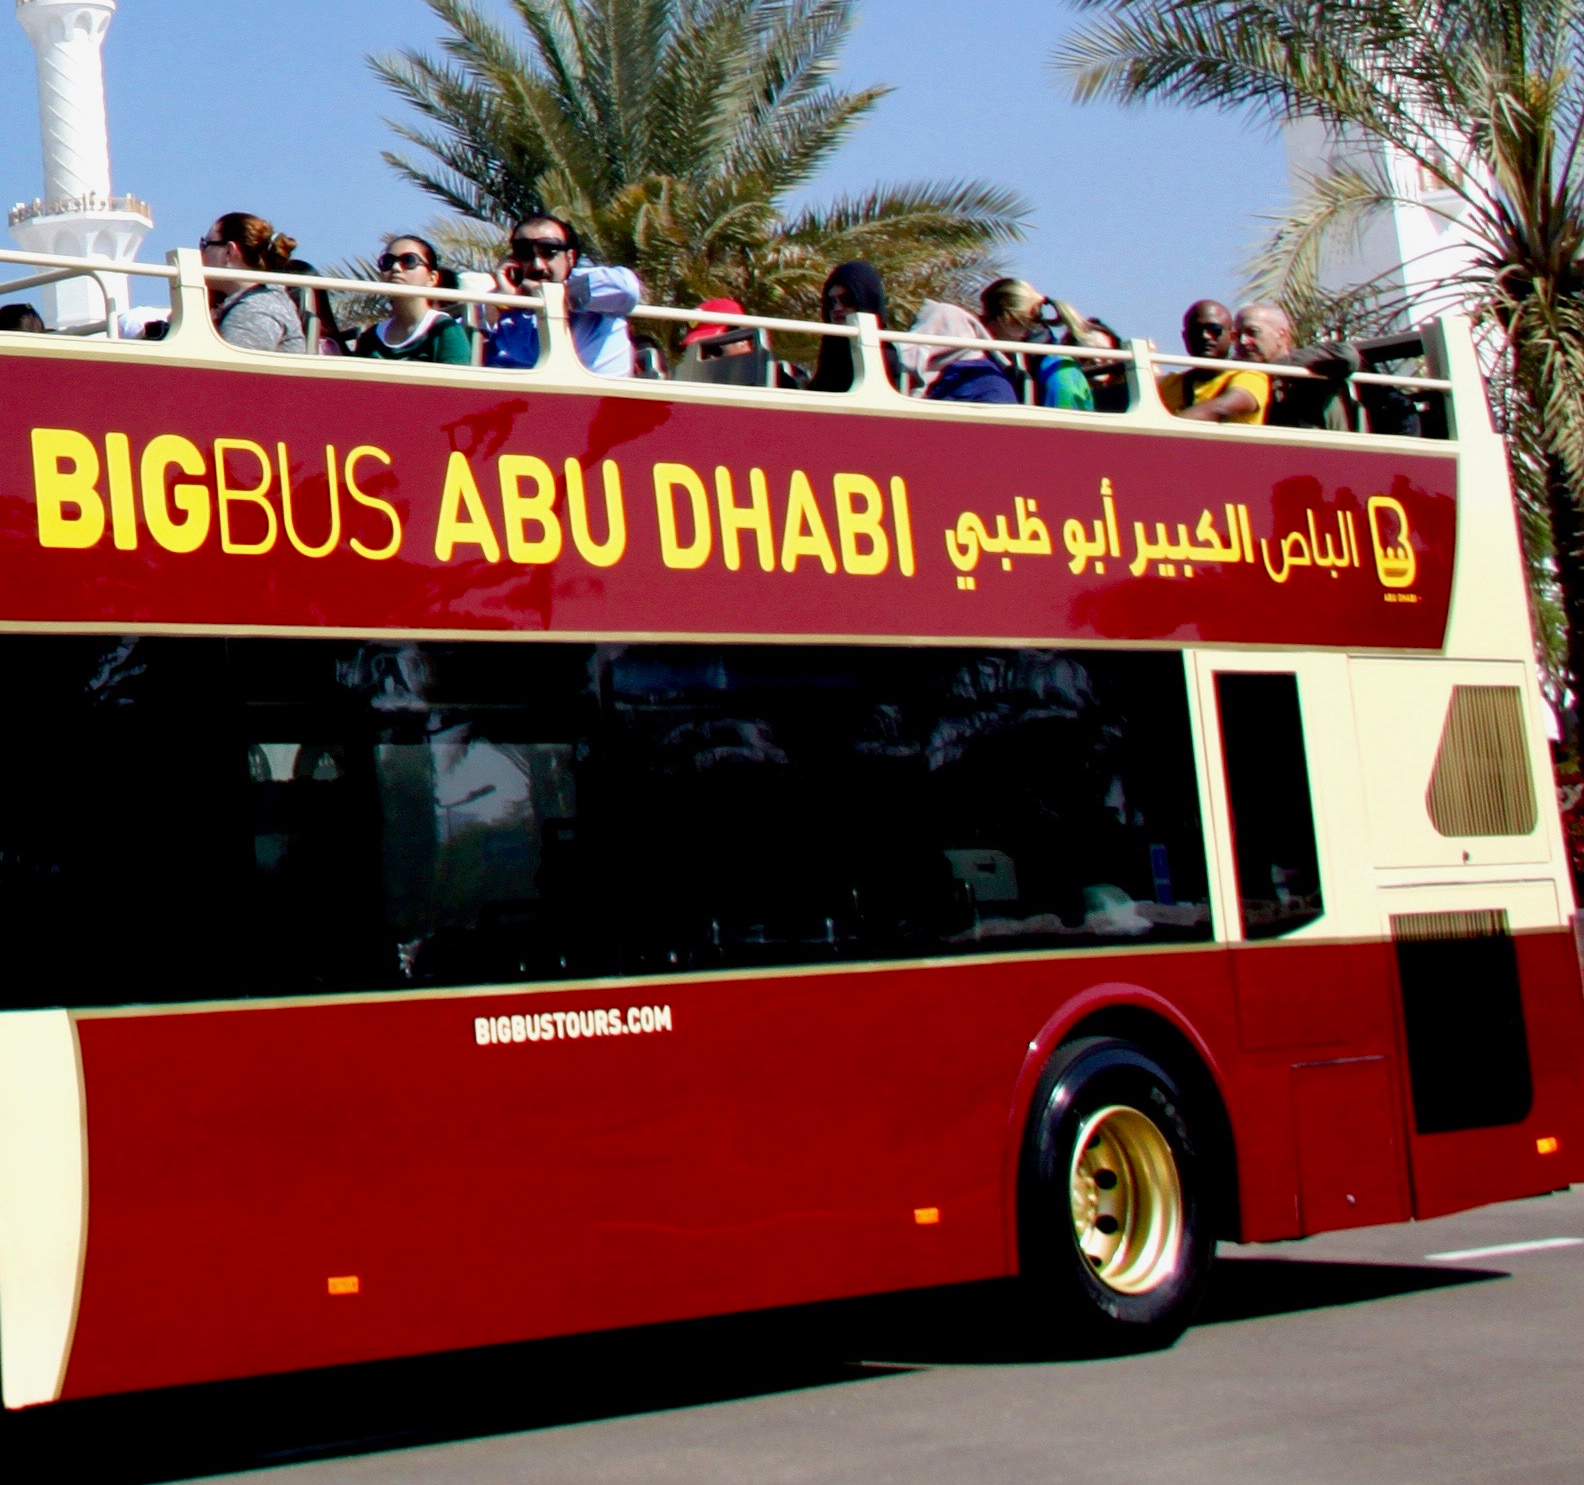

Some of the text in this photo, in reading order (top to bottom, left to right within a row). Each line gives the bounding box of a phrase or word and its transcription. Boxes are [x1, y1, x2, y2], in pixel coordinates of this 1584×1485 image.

[434, 450, 627, 568] ABU
[652, 462, 915, 578] DHABI
[944, 476, 1361, 591] الباص الكبير أبو ظبي
[474, 1004, 673, 1046] BIGBUSTOURS.COM
